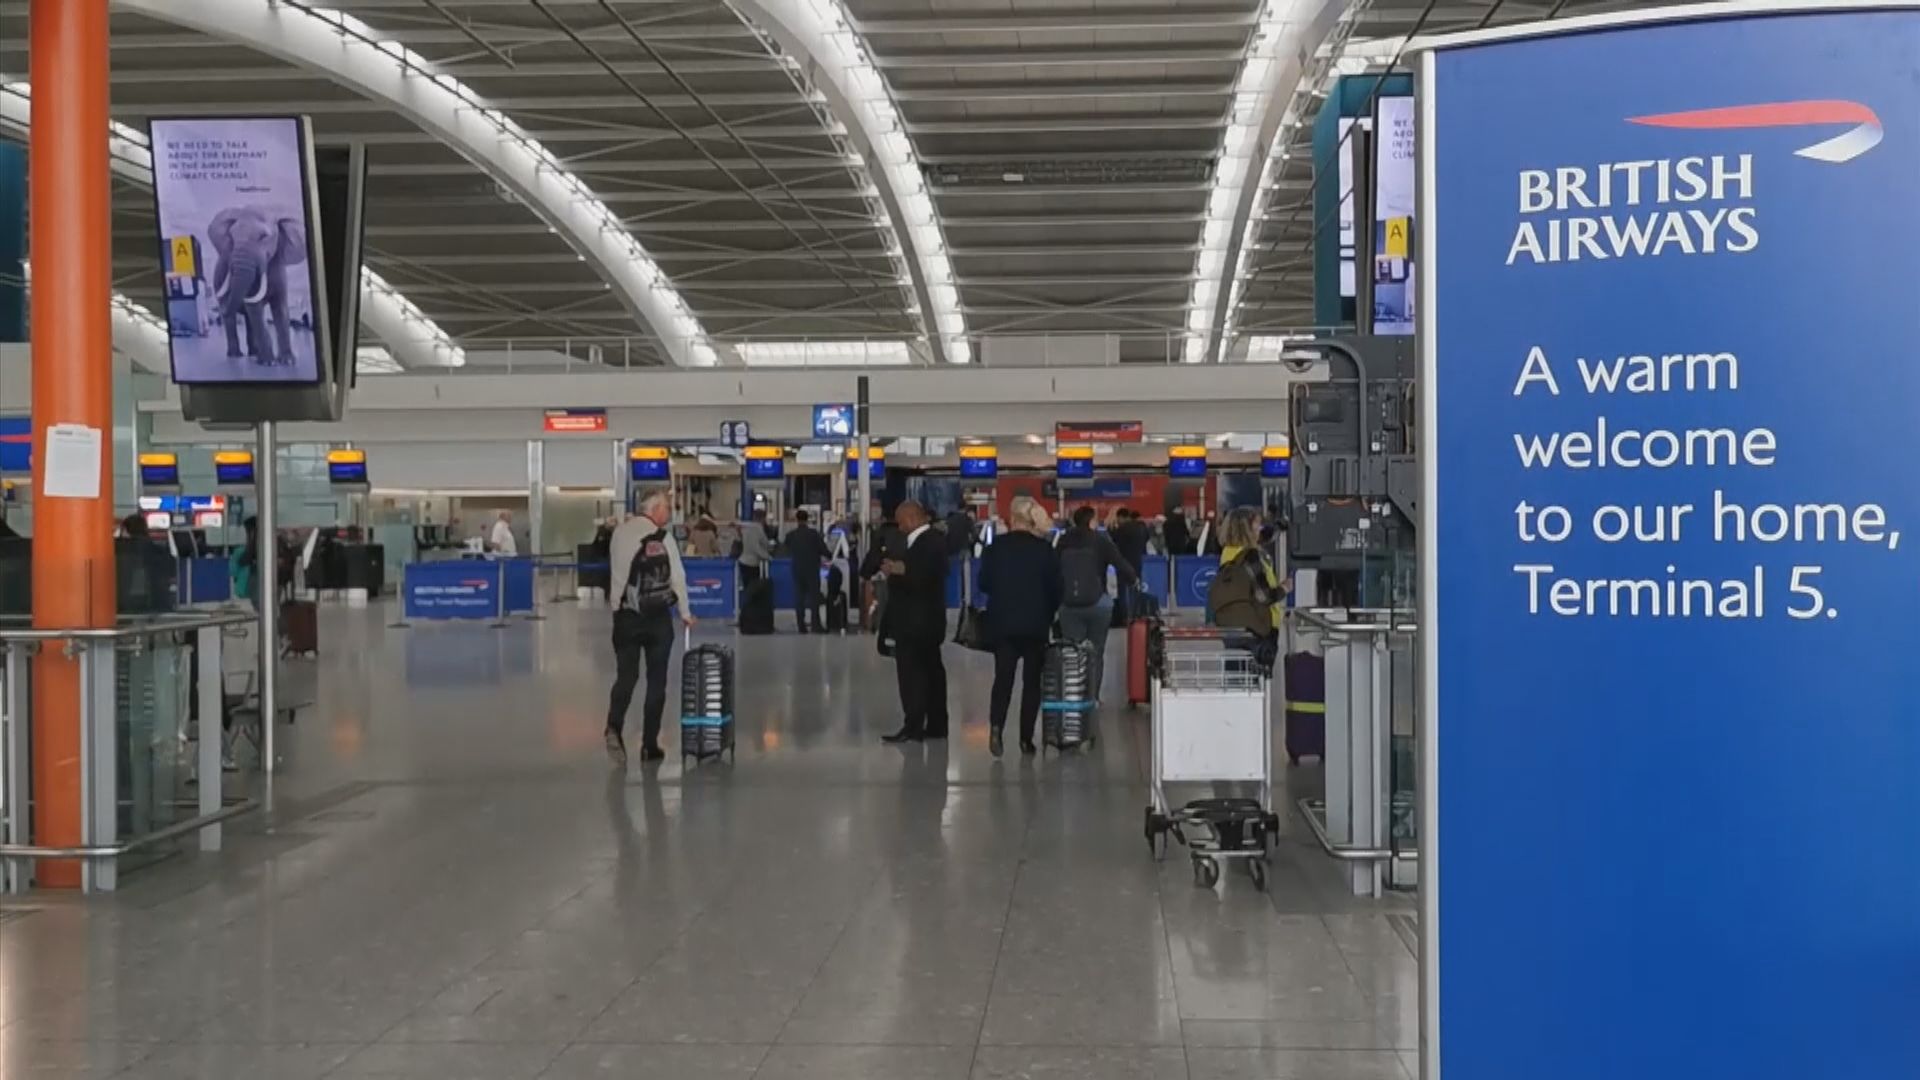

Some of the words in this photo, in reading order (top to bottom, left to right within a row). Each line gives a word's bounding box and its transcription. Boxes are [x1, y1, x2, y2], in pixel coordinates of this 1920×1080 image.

[184, 141, 208, 149] NEED
[211, 141, 222, 149] TO
[226, 141, 247, 149] TALK
[222, 150, 268, 159] ELEPHANT
[1392, 151, 1414, 159] CLIM
[1519, 154, 1753, 214] BRITISH
[176, 242, 188, 257] A
[1390, 224, 1402, 239] A
[1505, 207, 1759, 266] AIRWAYS
[1513, 346, 1560, 395] A
[1577, 352, 1738, 393] warm
[1513, 416, 1777, 467] welcome
[1514, 500, 1573, 541] to
[1593, 503, 1694, 542] our
[1714, 490, 1900, 549] home,
[1513, 564, 1764, 617] Terminal
[1787, 565, 1838, 619] 5.
